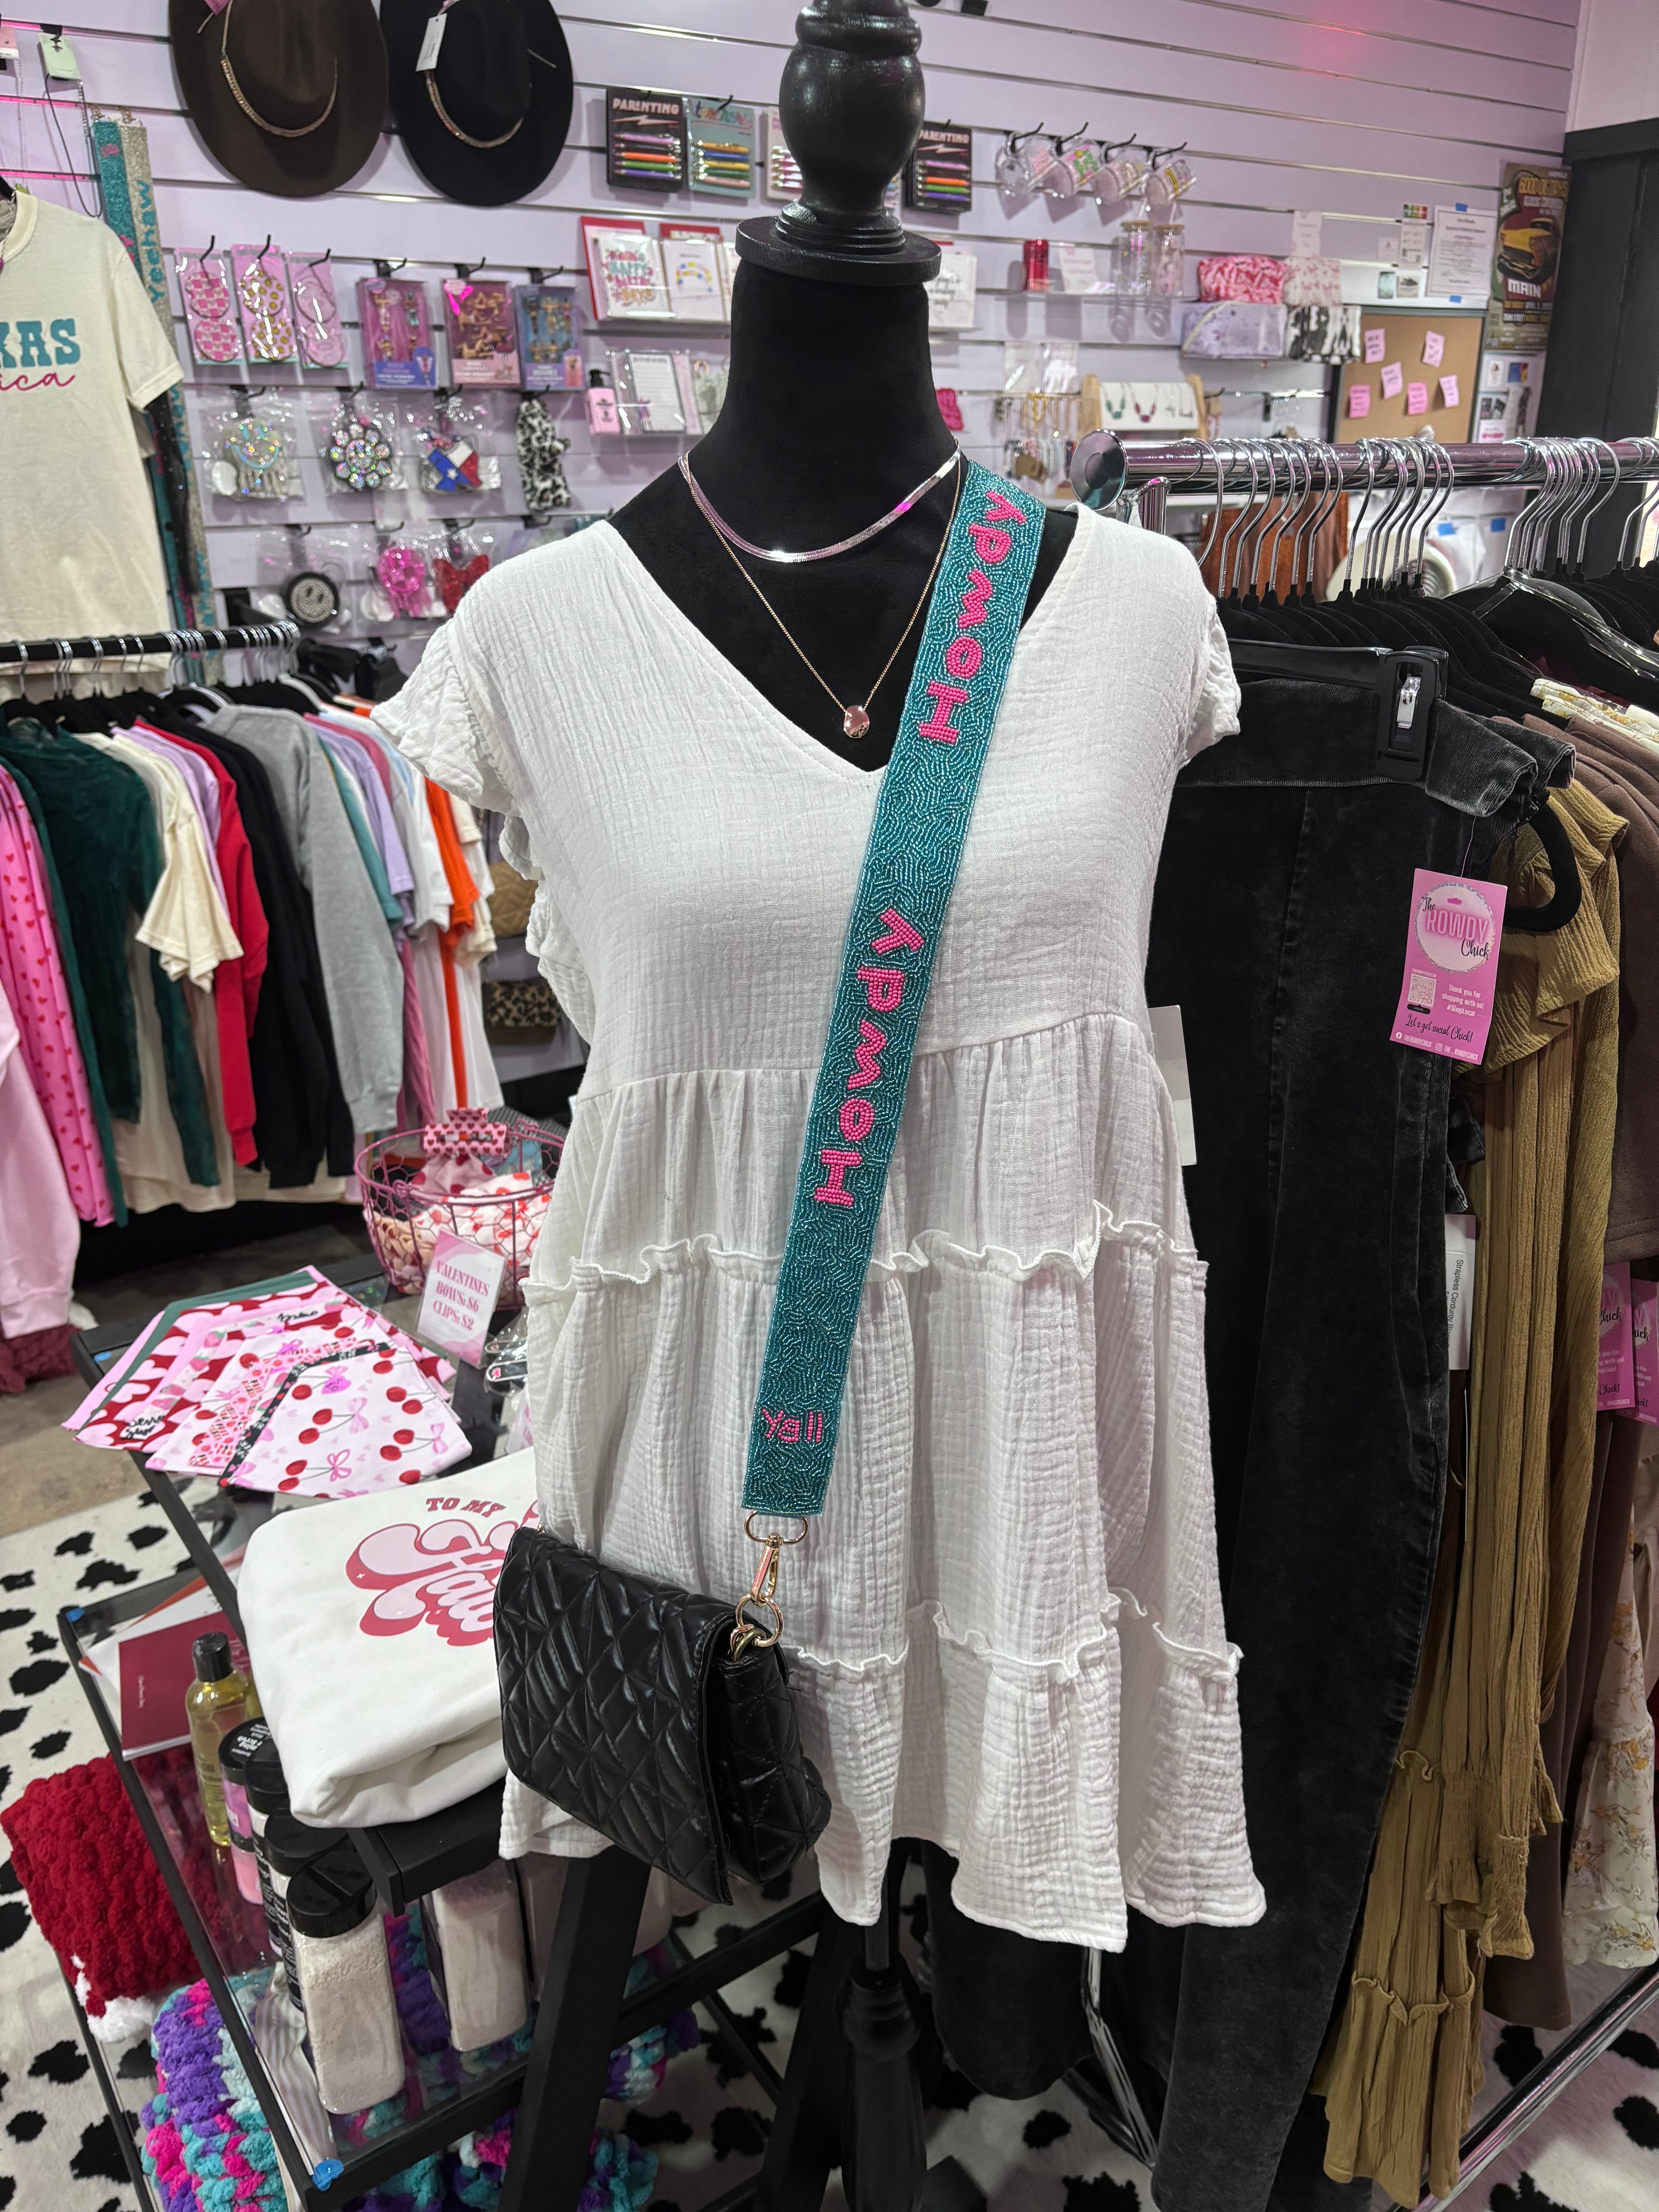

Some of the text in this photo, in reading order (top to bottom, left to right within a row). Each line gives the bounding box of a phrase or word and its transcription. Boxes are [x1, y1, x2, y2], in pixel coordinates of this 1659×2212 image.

[612, 98, 680, 115] PARENTING
[1507, 278, 1541, 299] MAIN
[919, 490, 1027, 746] Howdy
[1421, 896, 1437, 912] The
[1427, 909, 1489, 944] ROWDY
[1461, 938, 1490, 960] Chick
[1442, 993, 1463, 1005] shopping
[1464, 999, 1476, 1007] with
[1449, 984, 1462, 994] Thank
[1447, 1004, 1475, 1017] #ShopLocal
[1405, 1014, 1474, 1043] Let's get social Chick!
[813, 909, 925, 1207] Howdy
[436, 1260, 490, 1297] VALENTINES
[1452, 1259, 1464, 1291] Strapless
[1448, 1292, 1459, 1322] Corduroy
[426, 1497, 506, 1518] TO MY
